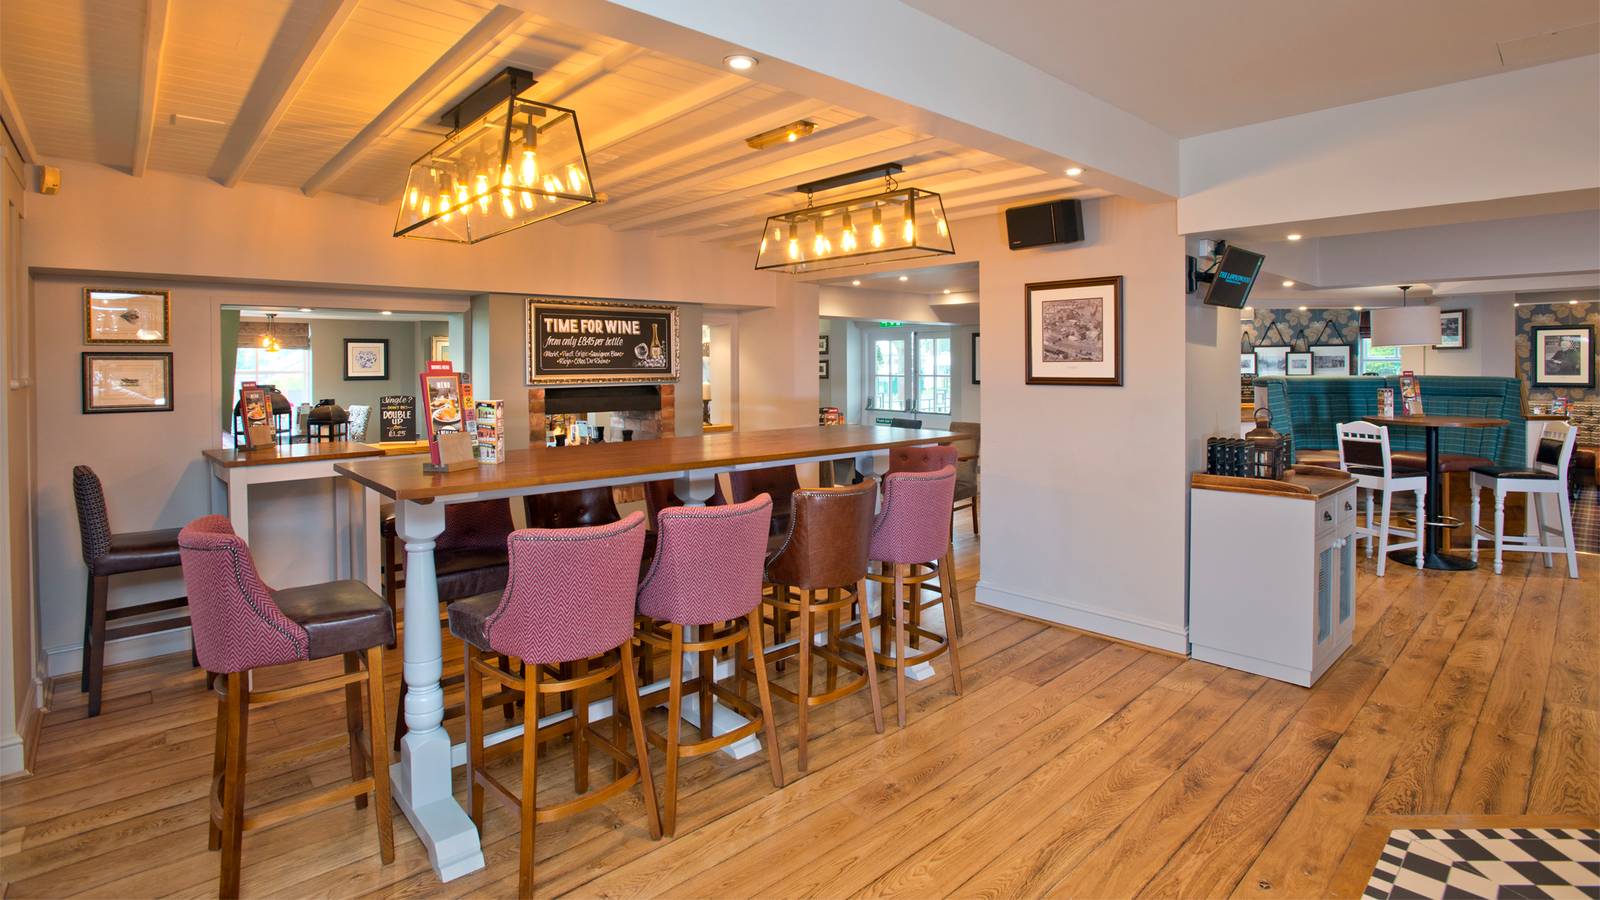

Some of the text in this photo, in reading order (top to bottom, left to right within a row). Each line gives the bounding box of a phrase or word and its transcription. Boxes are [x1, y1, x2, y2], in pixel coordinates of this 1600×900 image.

[544, 318, 640, 334] TIME FOR WINE
[543, 336, 561, 348] from
[562, 336, 577, 348] only
[594, 338, 604, 347] per
[605, 337, 624, 346] bottle
[383, 410, 412, 420] DOUBLE
